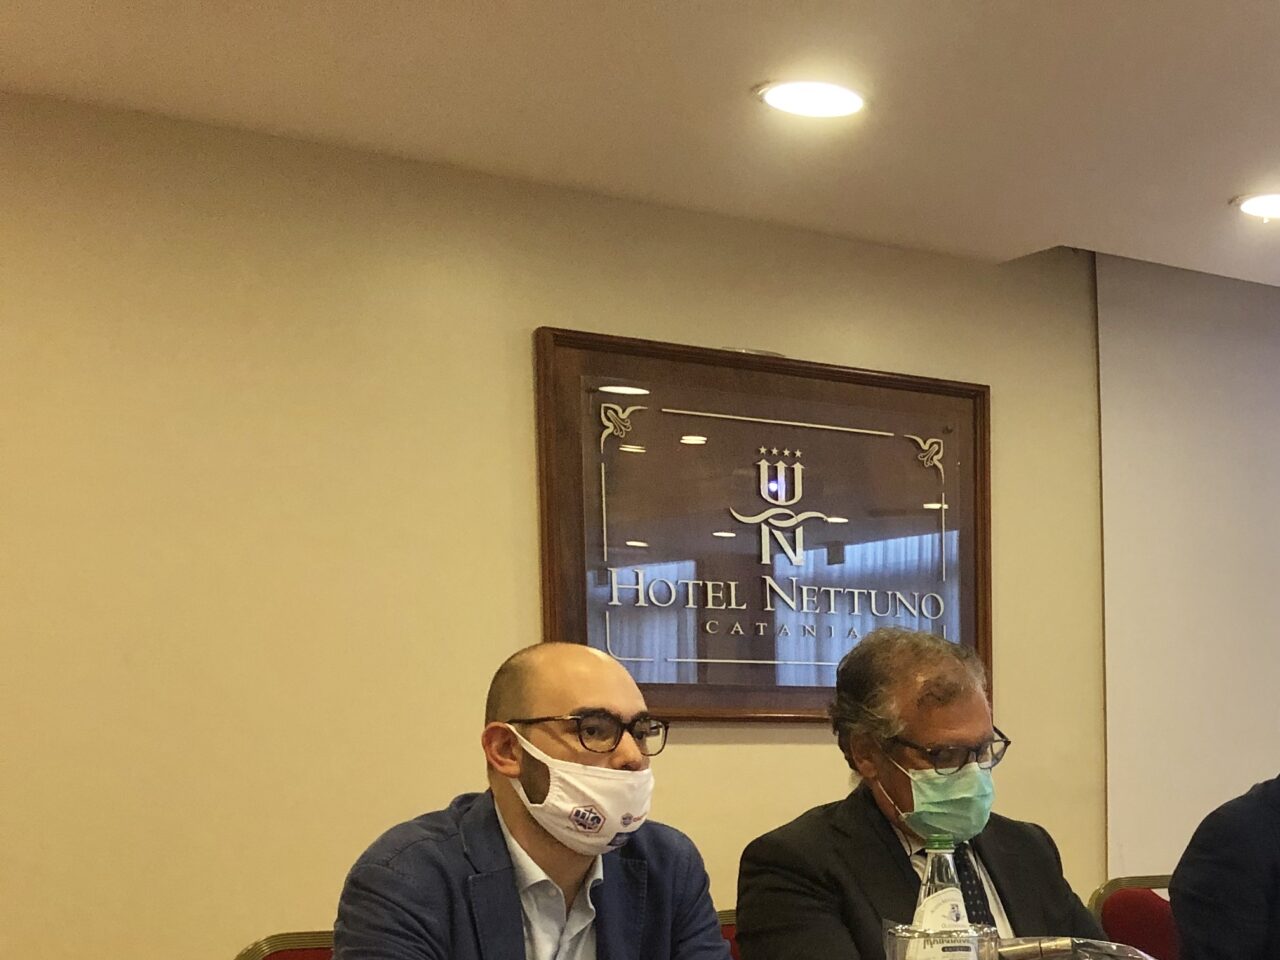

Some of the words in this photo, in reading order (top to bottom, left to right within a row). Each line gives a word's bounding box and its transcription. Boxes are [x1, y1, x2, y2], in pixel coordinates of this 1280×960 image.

[606, 567, 747, 611] HOTEL
[761, 575, 945, 621] NETTUNO
[705, 619, 860, 639] CATANIA
